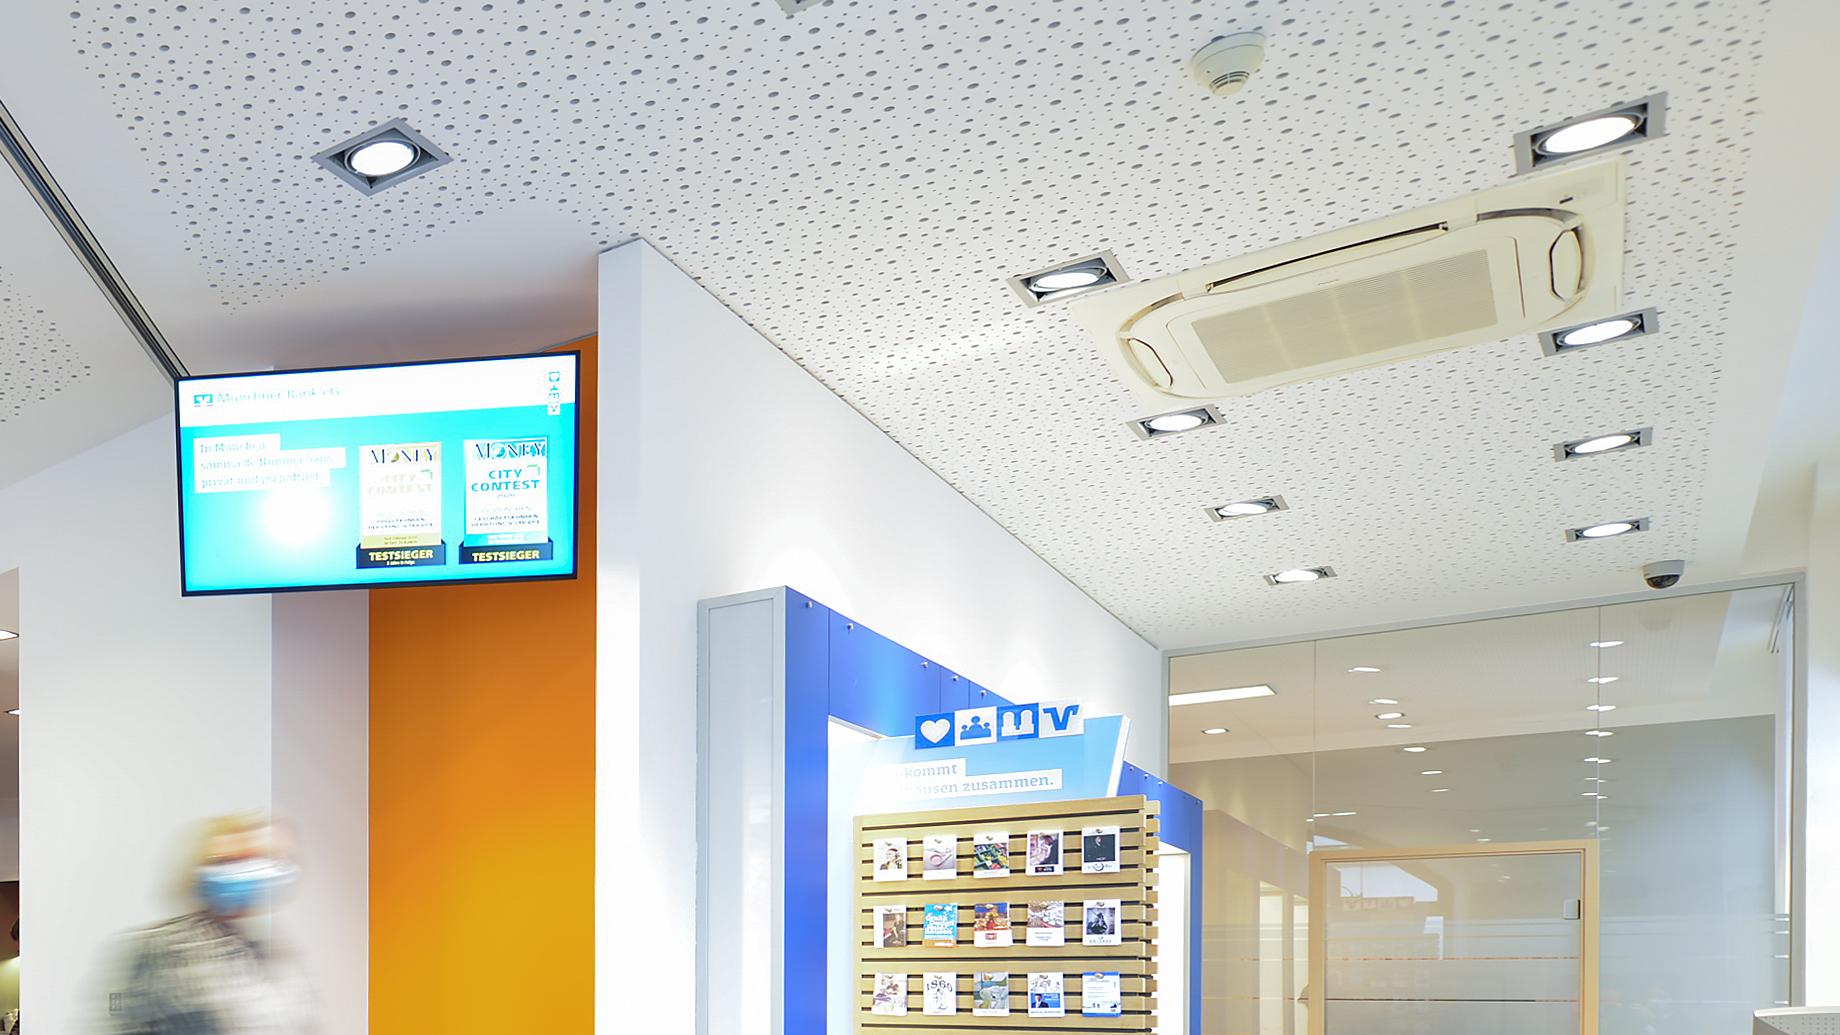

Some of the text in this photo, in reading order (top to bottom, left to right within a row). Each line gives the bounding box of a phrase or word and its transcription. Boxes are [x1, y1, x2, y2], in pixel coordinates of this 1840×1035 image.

[488, 469, 523, 480] CITY
[471, 479, 541, 493] CONTEST
[368, 549, 434, 562] TESTSIEGER
[471, 550, 541, 562] TESTSIEGER
[904, 763, 958, 779] kommt
[962, 774, 1054, 792] zusammen.
